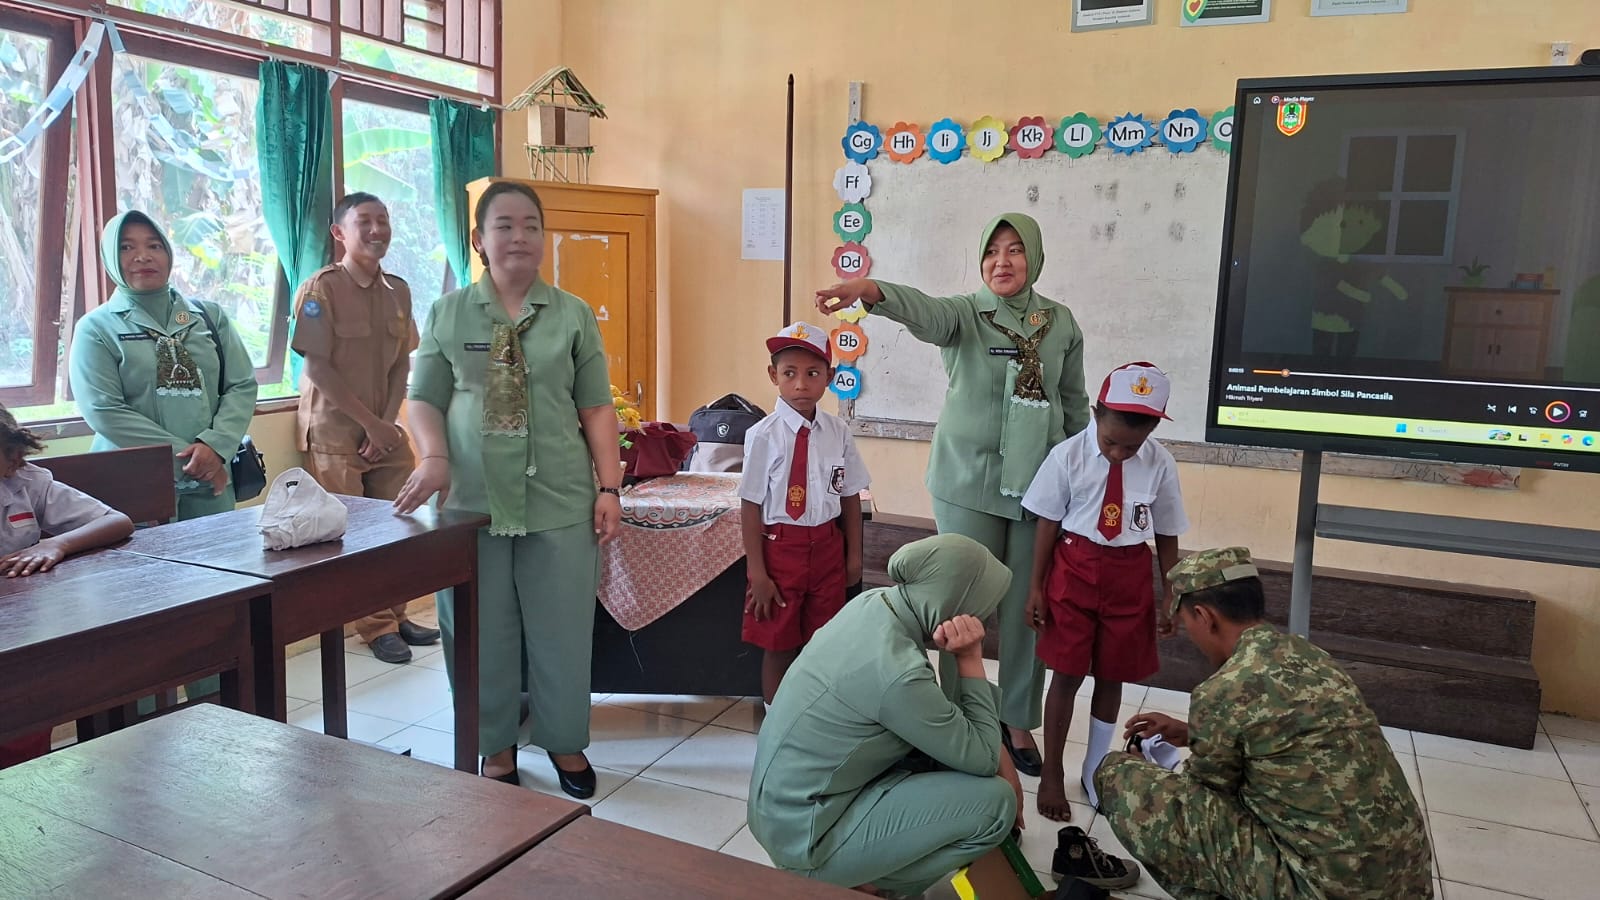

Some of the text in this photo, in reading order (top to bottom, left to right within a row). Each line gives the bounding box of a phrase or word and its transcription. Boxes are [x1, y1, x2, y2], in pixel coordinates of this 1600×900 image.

[851, 121, 1233, 151] Gg Hh Ii Jj Kk Ll Mm Nn O
[845, 175, 860, 189] Ff
[843, 215, 861, 229] Ee
[840, 255, 861, 269] Dd
[839, 334, 858, 348] Bb
[835, 373, 856, 388] Aa
[1226, 383, 1394, 401] Animasi Pembelajaran Simbol Sila Pancasila
